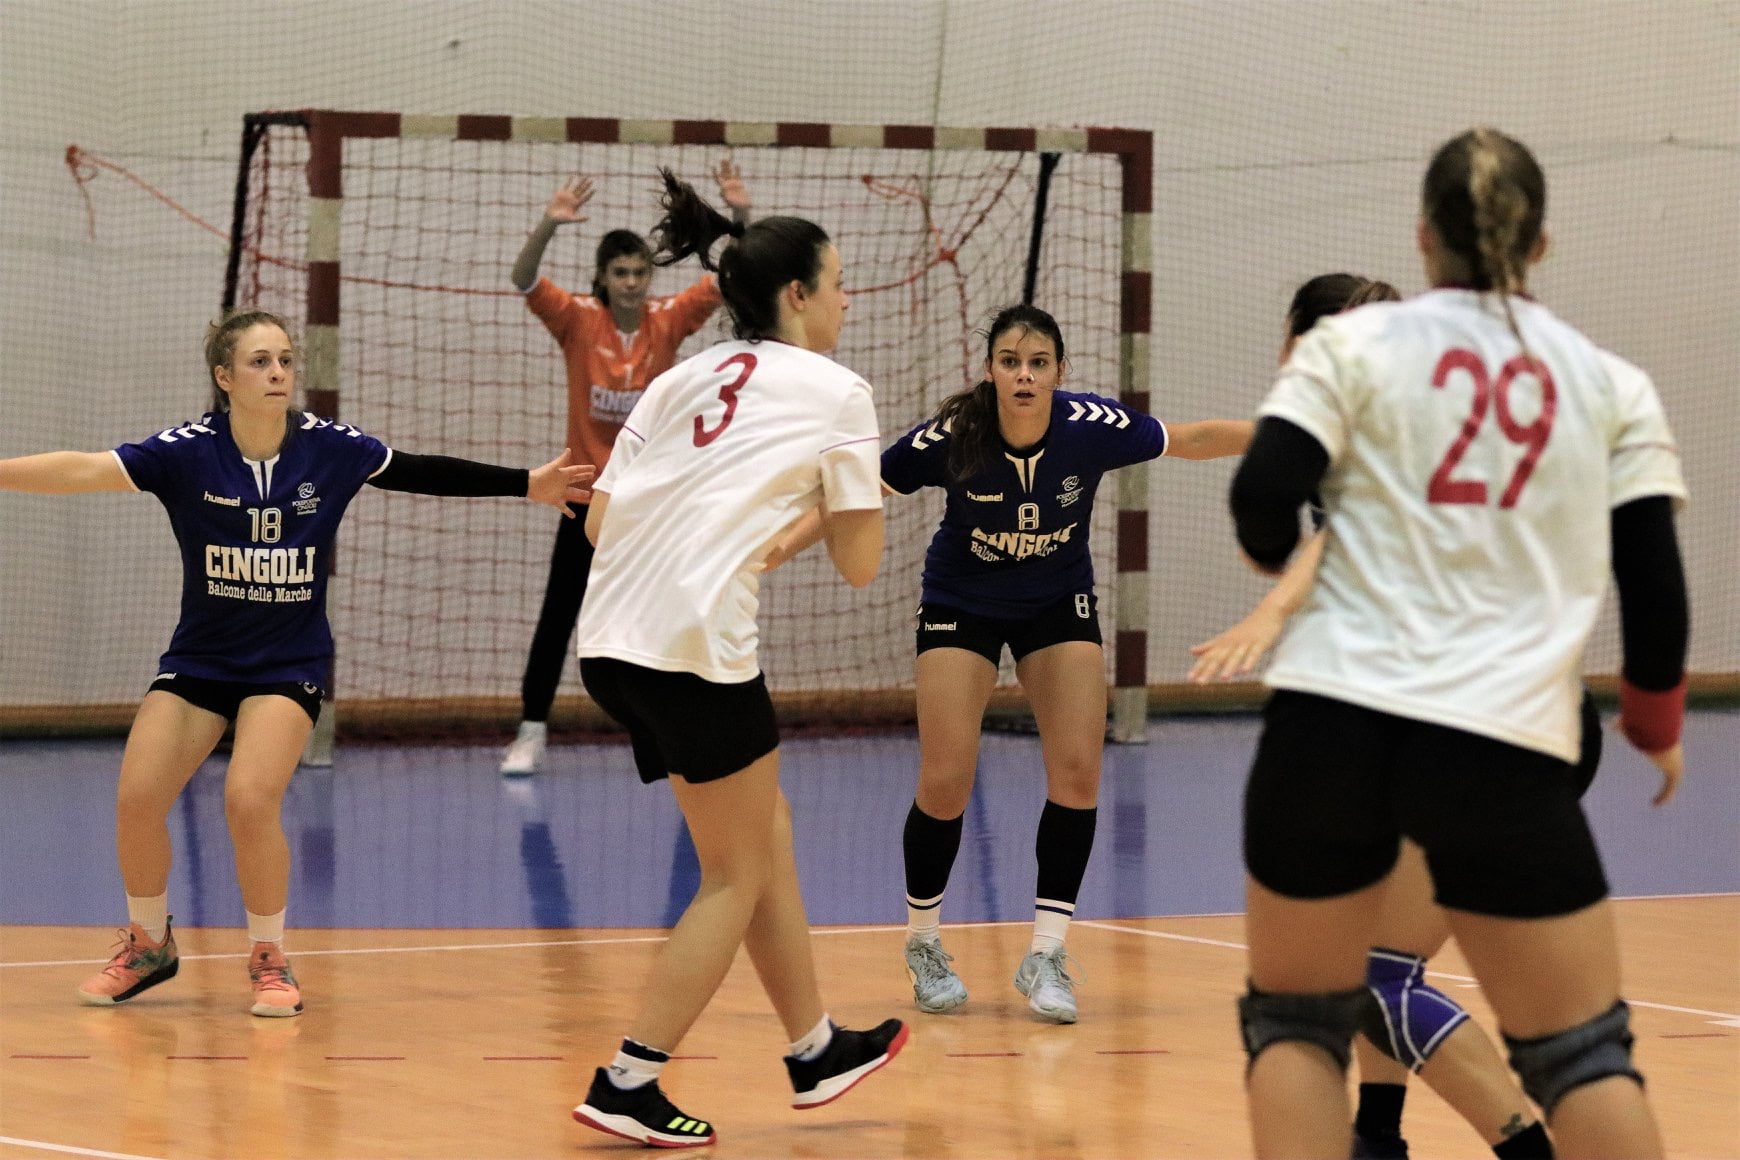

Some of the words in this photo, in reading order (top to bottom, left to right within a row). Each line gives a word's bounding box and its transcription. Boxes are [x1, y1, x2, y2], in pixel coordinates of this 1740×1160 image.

[693, 352, 758, 448] 3
[1427, 348, 1557, 509] 29
[204, 490, 241, 507] hummel
[967, 490, 1004, 502] hummel
[246, 507, 282, 543] 18
[1018, 502, 1039, 531] 8
[205, 544, 316, 584] CINGOLI
[970, 540, 1005, 562] Balcon
[207, 580, 245, 599] Balcone
[247, 586, 272, 603] delle
[275, 587, 312, 603] Marche
[1075, 593, 1090, 619] 8
[925, 621, 957, 631] hummel
